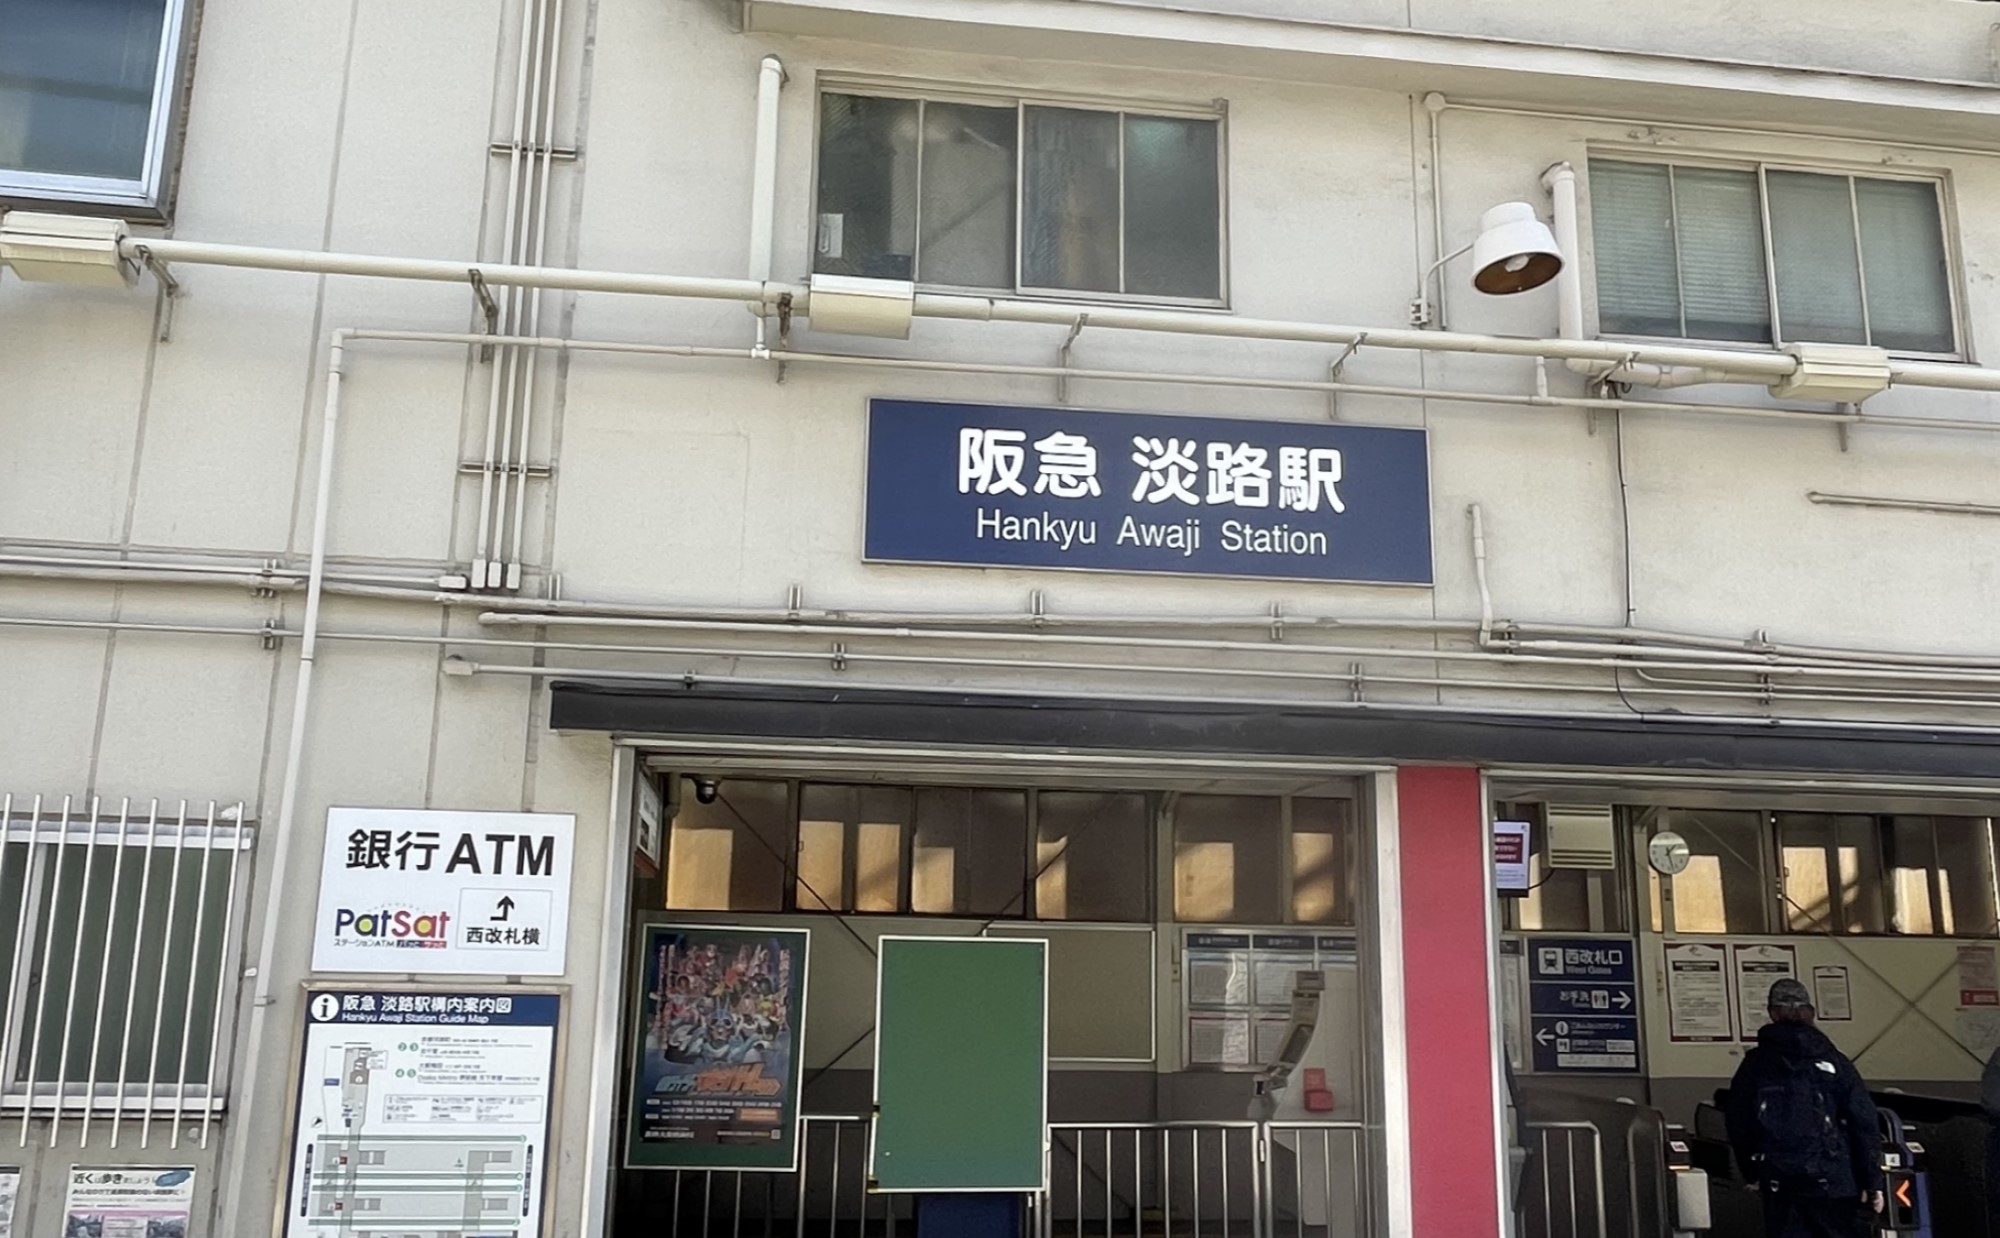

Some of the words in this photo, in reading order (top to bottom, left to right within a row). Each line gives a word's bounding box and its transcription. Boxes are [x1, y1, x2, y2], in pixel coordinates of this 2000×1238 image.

[958, 428, 1102, 498] 阪急
[1131, 435, 1345, 513] 淡路駅
[976, 508, 1096, 550] Hankyu
[1116, 515, 1200, 556] Awaji
[1220, 520, 1327, 555] Station
[335, 908, 450, 938] PatSat
[466, 927, 540, 945] 西改札横
[1565, 948, 1623, 965] 西改札口
[343, 995, 375, 1011] 阪急
[381, 996, 512, 1014] 淡路駅構内案内図
[342, 1013, 377, 1023] Hankyu
[379, 1013, 403, 1023] Awaji
[405, 1013, 437, 1023] Station
[439, 1014, 466, 1023] Guide
[468, 1014, 489, 1024] Map
